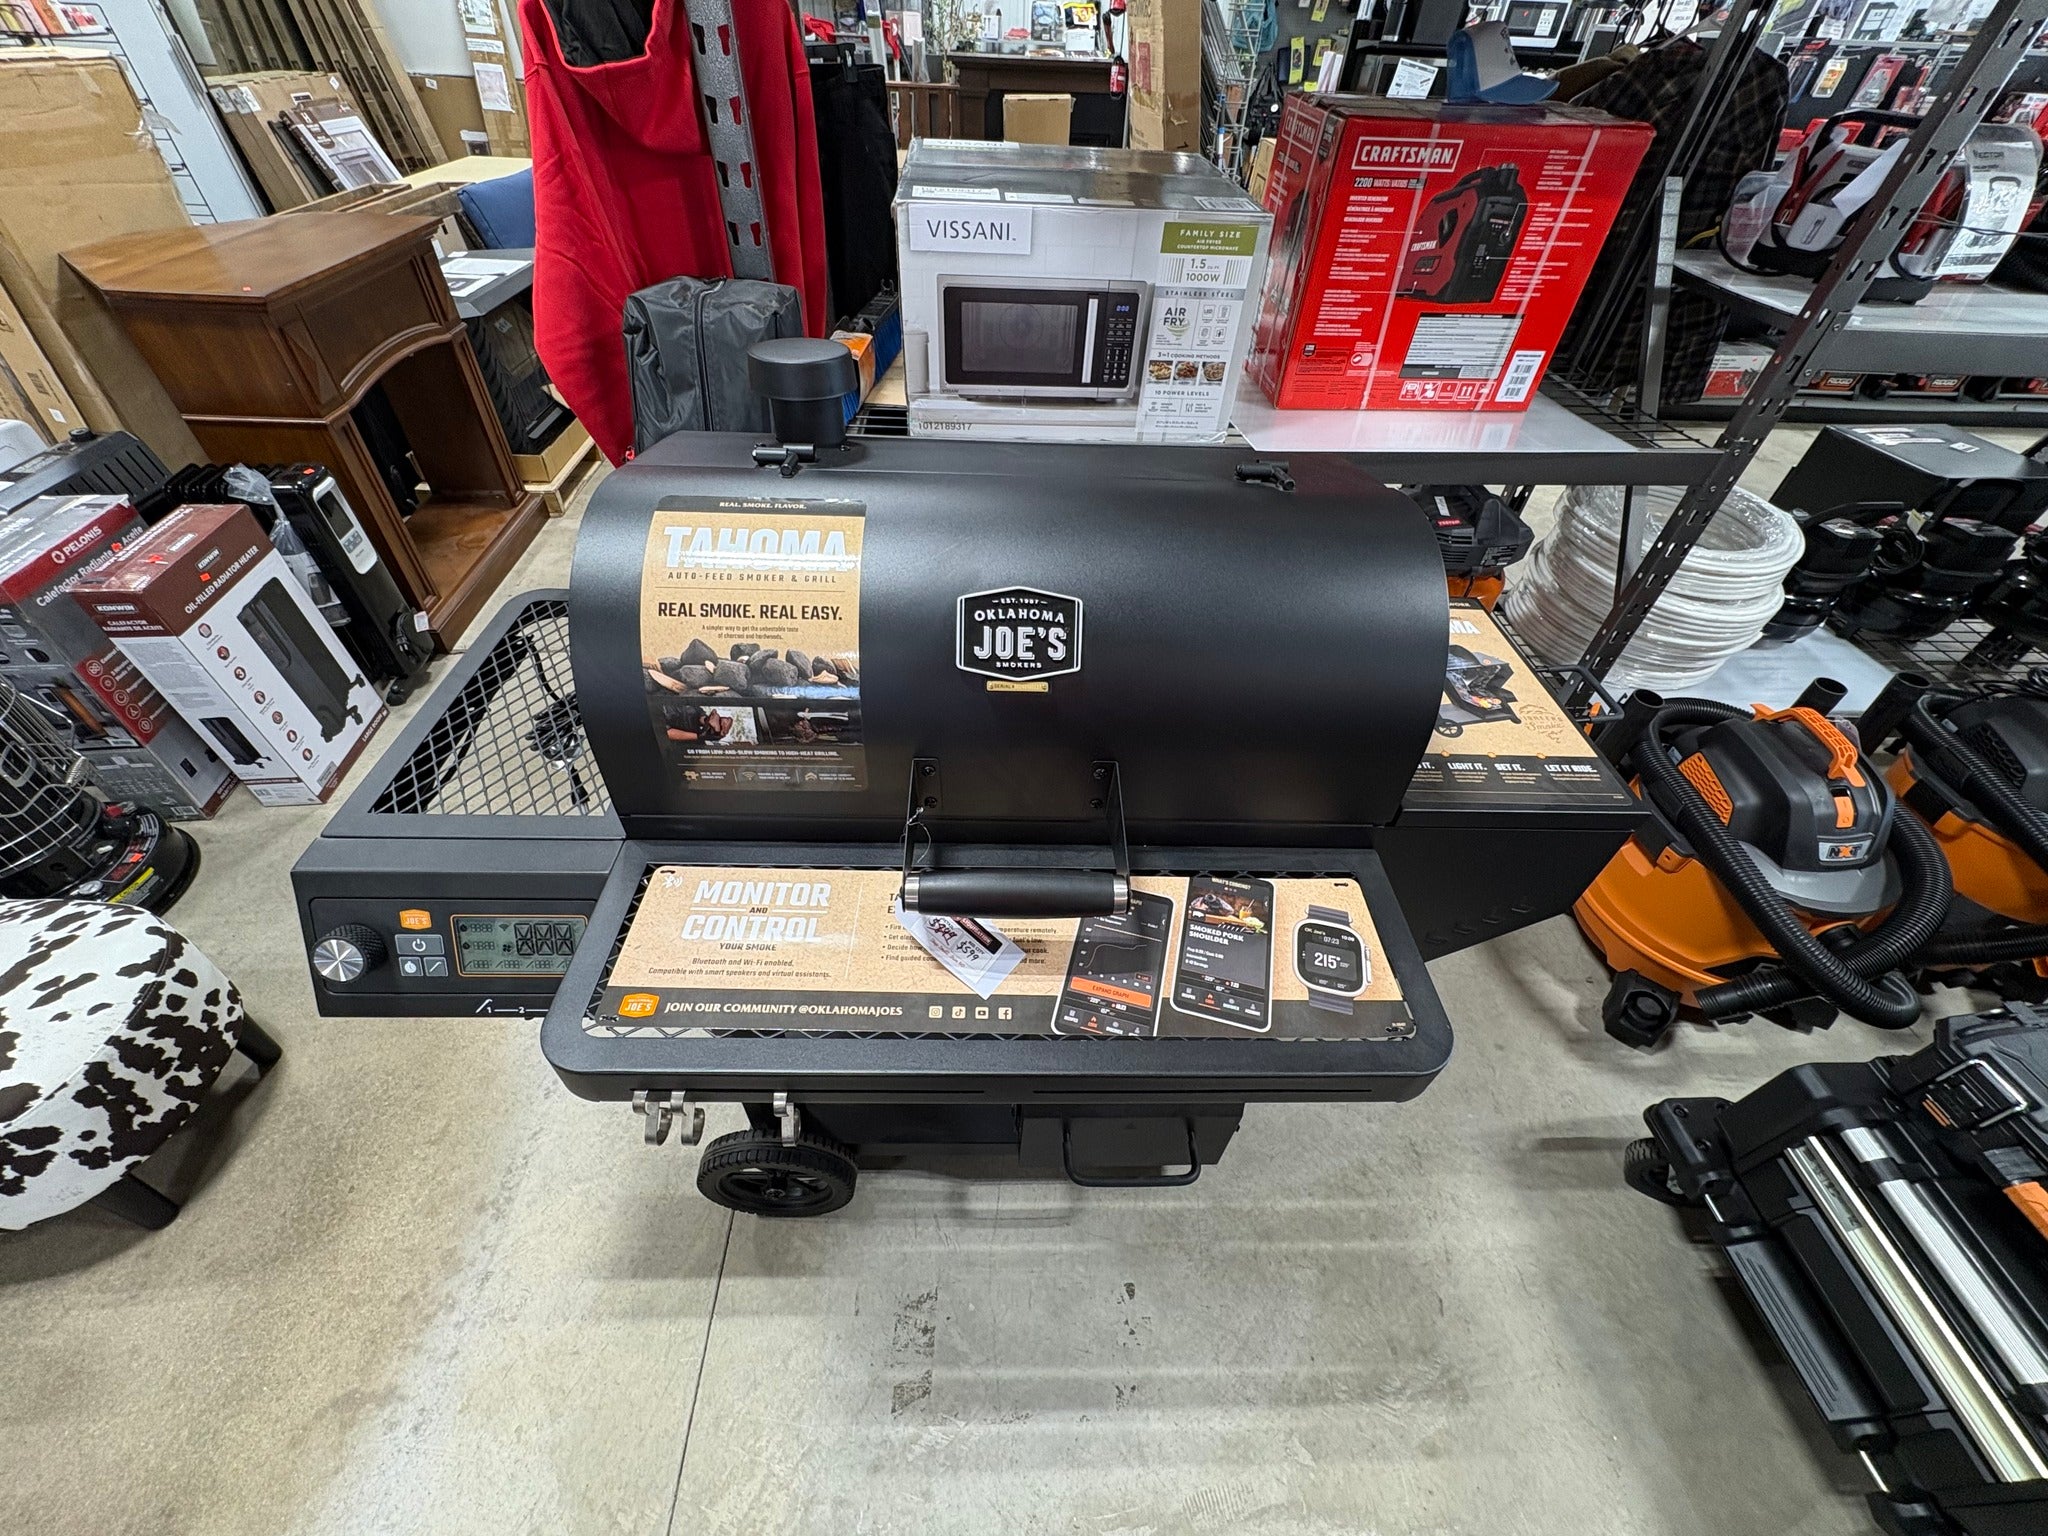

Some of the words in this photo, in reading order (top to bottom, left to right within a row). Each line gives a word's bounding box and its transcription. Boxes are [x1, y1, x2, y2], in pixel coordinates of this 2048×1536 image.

[1360, 145, 1454, 164] CRAFTSMAN
[1354, 177, 1373, 188] 2200
[926, 219, 1011, 242] VISSANI
[1179, 229, 1215, 238] FAMILY
[1219, 230, 1241, 239] SIZE
[1190, 258, 1207, 269] 1.5
[1186, 273, 1220, 282] 1000W
[1165, 307, 1187, 316] AIR
[1163, 317, 1185, 327] FRY
[719, 501, 741, 509] REAL.
[742, 502, 773, 510] SMOKE.
[774, 503, 807, 511] FLAVOR.
[121, 524, 144, 546] Aceite
[63, 525, 103, 557] PELONIS
[663, 526, 851, 572] TAHOMA
[197, 549, 220, 569] KONWIN
[36, 571, 80, 607] Calefactor
[79, 549, 114, 578] Radiante
[184, 583, 216, 615] OIL-FILLED
[212, 561, 242, 592] RADIATOR
[238, 545, 260, 570] HEATER
[667, 572, 733, 582] AUTO-FEED
[739, 573, 785, 583] SMOKER
[791, 575, 798, 583] &
[804, 575, 837, 584] GRILL
[96, 604, 136, 612] KONWIN
[658, 602, 697, 618] REAL
[700, 603, 755, 620] SMOKE.
[759, 604, 798, 621] REAL
[801, 605, 843, 621] EASY.
[973, 608, 1065, 624] OKLAHOMA
[707, 624, 725, 633] simpler
[741, 625, 750, 634] get
[758, 625, 786, 633] unbeatable
[724, 632, 745, 640] charcoal
[973, 625, 1067, 660] JOE'S
[995, 661, 1042, 669] SMOKERS
[1447, 762, 1474, 770] LIGHT
[1474, 763, 1488, 771] IT.
[1544, 764, 1563, 772] LET
[1573, 765, 1598, 773] RIDE.
[1828, 846, 1861, 857] NXT
[692, 879, 832, 906] MONITOR
[749, 906, 768, 914] AND
[404, 916, 428, 925] JOE'S
[680, 914, 823, 943] CONTROL
[1189, 924, 1222, 936] SMOKED
[1222, 931, 1244, 942] PORK
[1189, 931, 1229, 945] SHOULDER
[1323, 936, 1340, 945] 07:23
[719, 942, 744, 951] YOUR
[745, 943, 777, 952] SMOKE
[956, 940, 980, 961] $599
[692, 958, 727, 966] Bluetooth
[728, 958, 742, 966] and
[743, 958, 763, 966] Wi-Fi
[763, 958, 794, 967] enabled.
[648, 967, 687, 977] Compatible
[725, 969, 757, 978] speakers
[757, 969, 771, 977] and
[771, 969, 794, 977] virtual
[795, 970, 832, 978] assistants.
[1092, 984, 1113, 995] EXPAND
[624, 1002, 652, 1012] JOE'S
[664, 1001, 695, 1014] JOIN
[696, 1003, 721, 1014] OUR
[722, 1003, 798, 1015] COMMUNITY
[798, 1005, 903, 1017] @OKLAHOMAJOES
